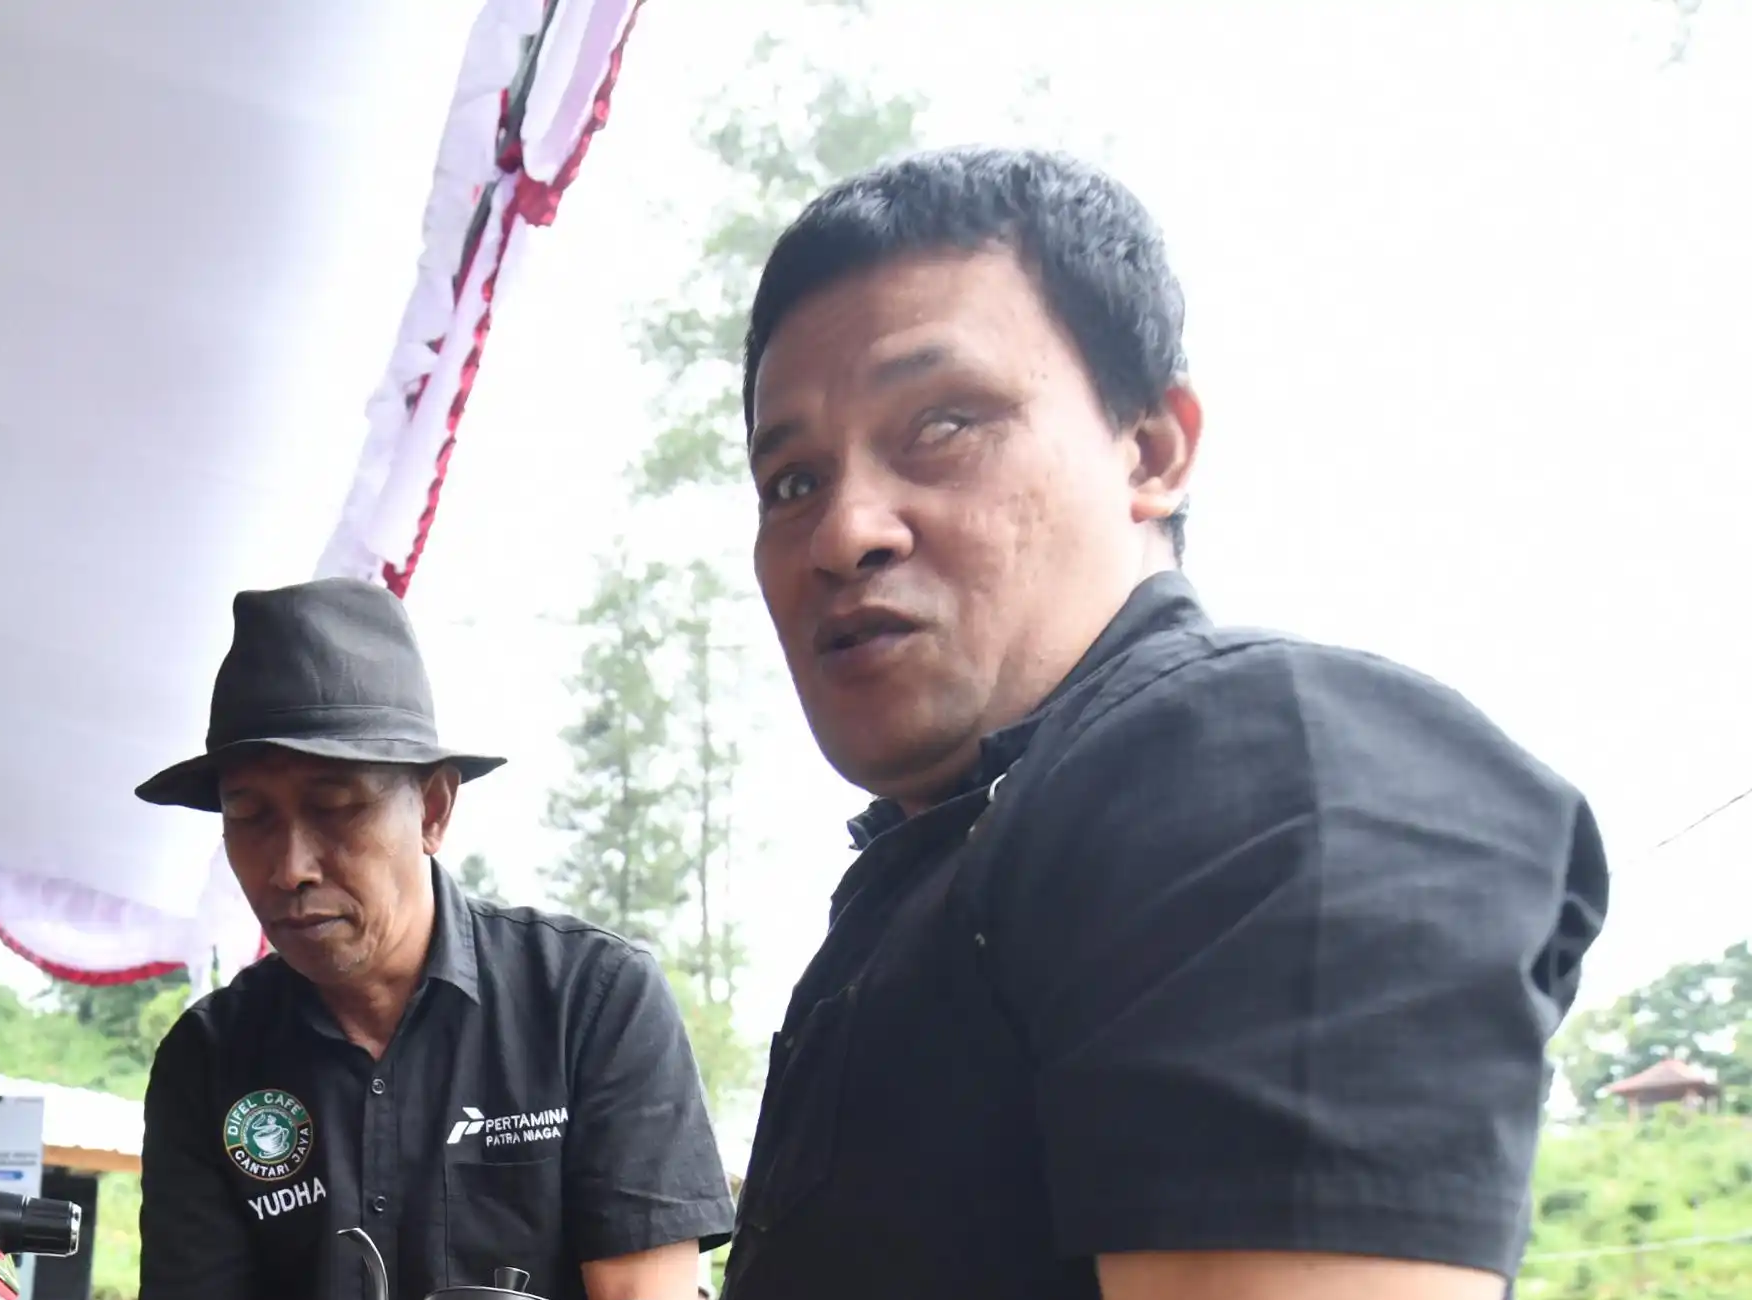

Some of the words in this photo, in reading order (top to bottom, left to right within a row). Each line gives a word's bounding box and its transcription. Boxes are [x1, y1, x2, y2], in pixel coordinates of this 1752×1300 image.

[227, 1098, 257, 1136] DIFEL
[485, 1107, 569, 1133] PERTAMINA
[234, 1150, 290, 1178] CANTARI
[291, 1127, 309, 1163] JAYA
[486, 1132, 521, 1147] PATRA
[523, 1126, 561, 1142] NIAGA
[248, 1177, 327, 1220] YUDHA
